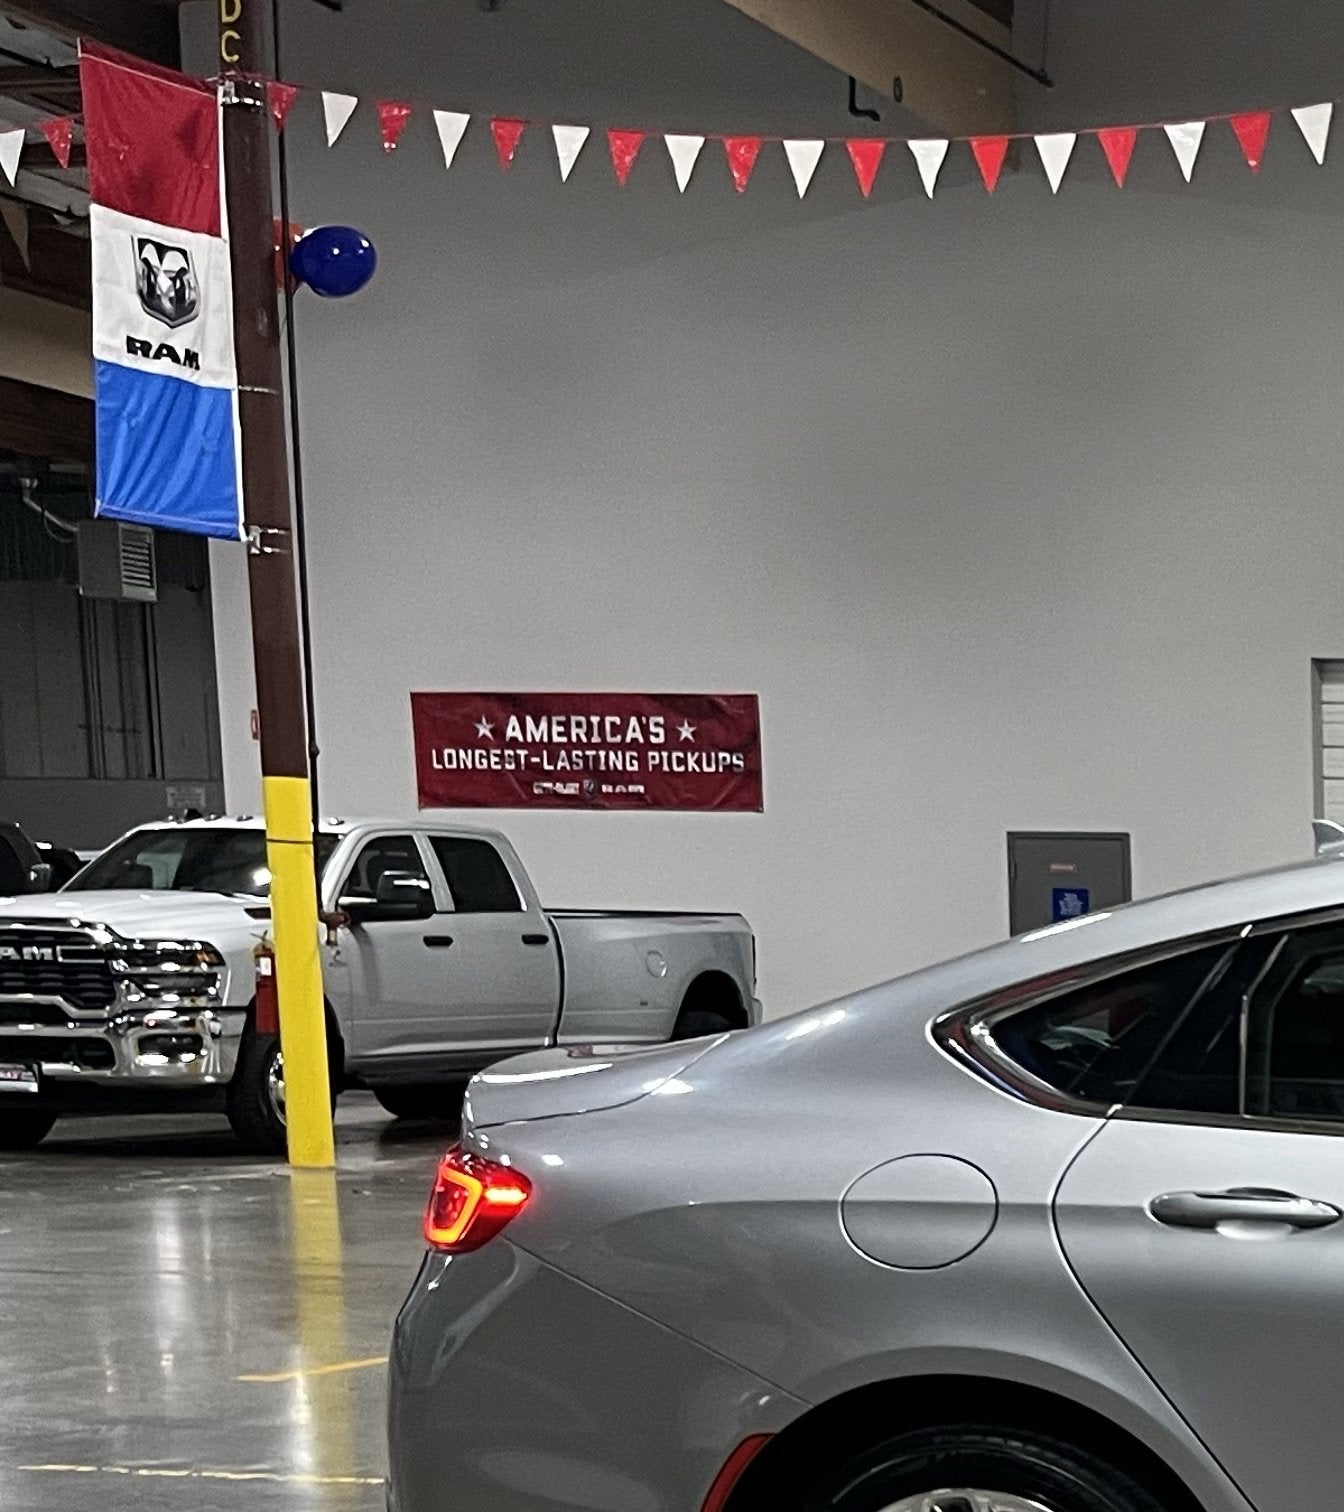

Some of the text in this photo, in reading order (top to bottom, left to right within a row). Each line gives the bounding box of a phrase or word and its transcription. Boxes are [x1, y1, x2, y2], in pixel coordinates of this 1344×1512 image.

[126, 335, 200, 370] RAM
[505, 715, 665, 743] AMERICA'S
[432, 748, 744, 773] LONGEST-LASTING PICKUPS
